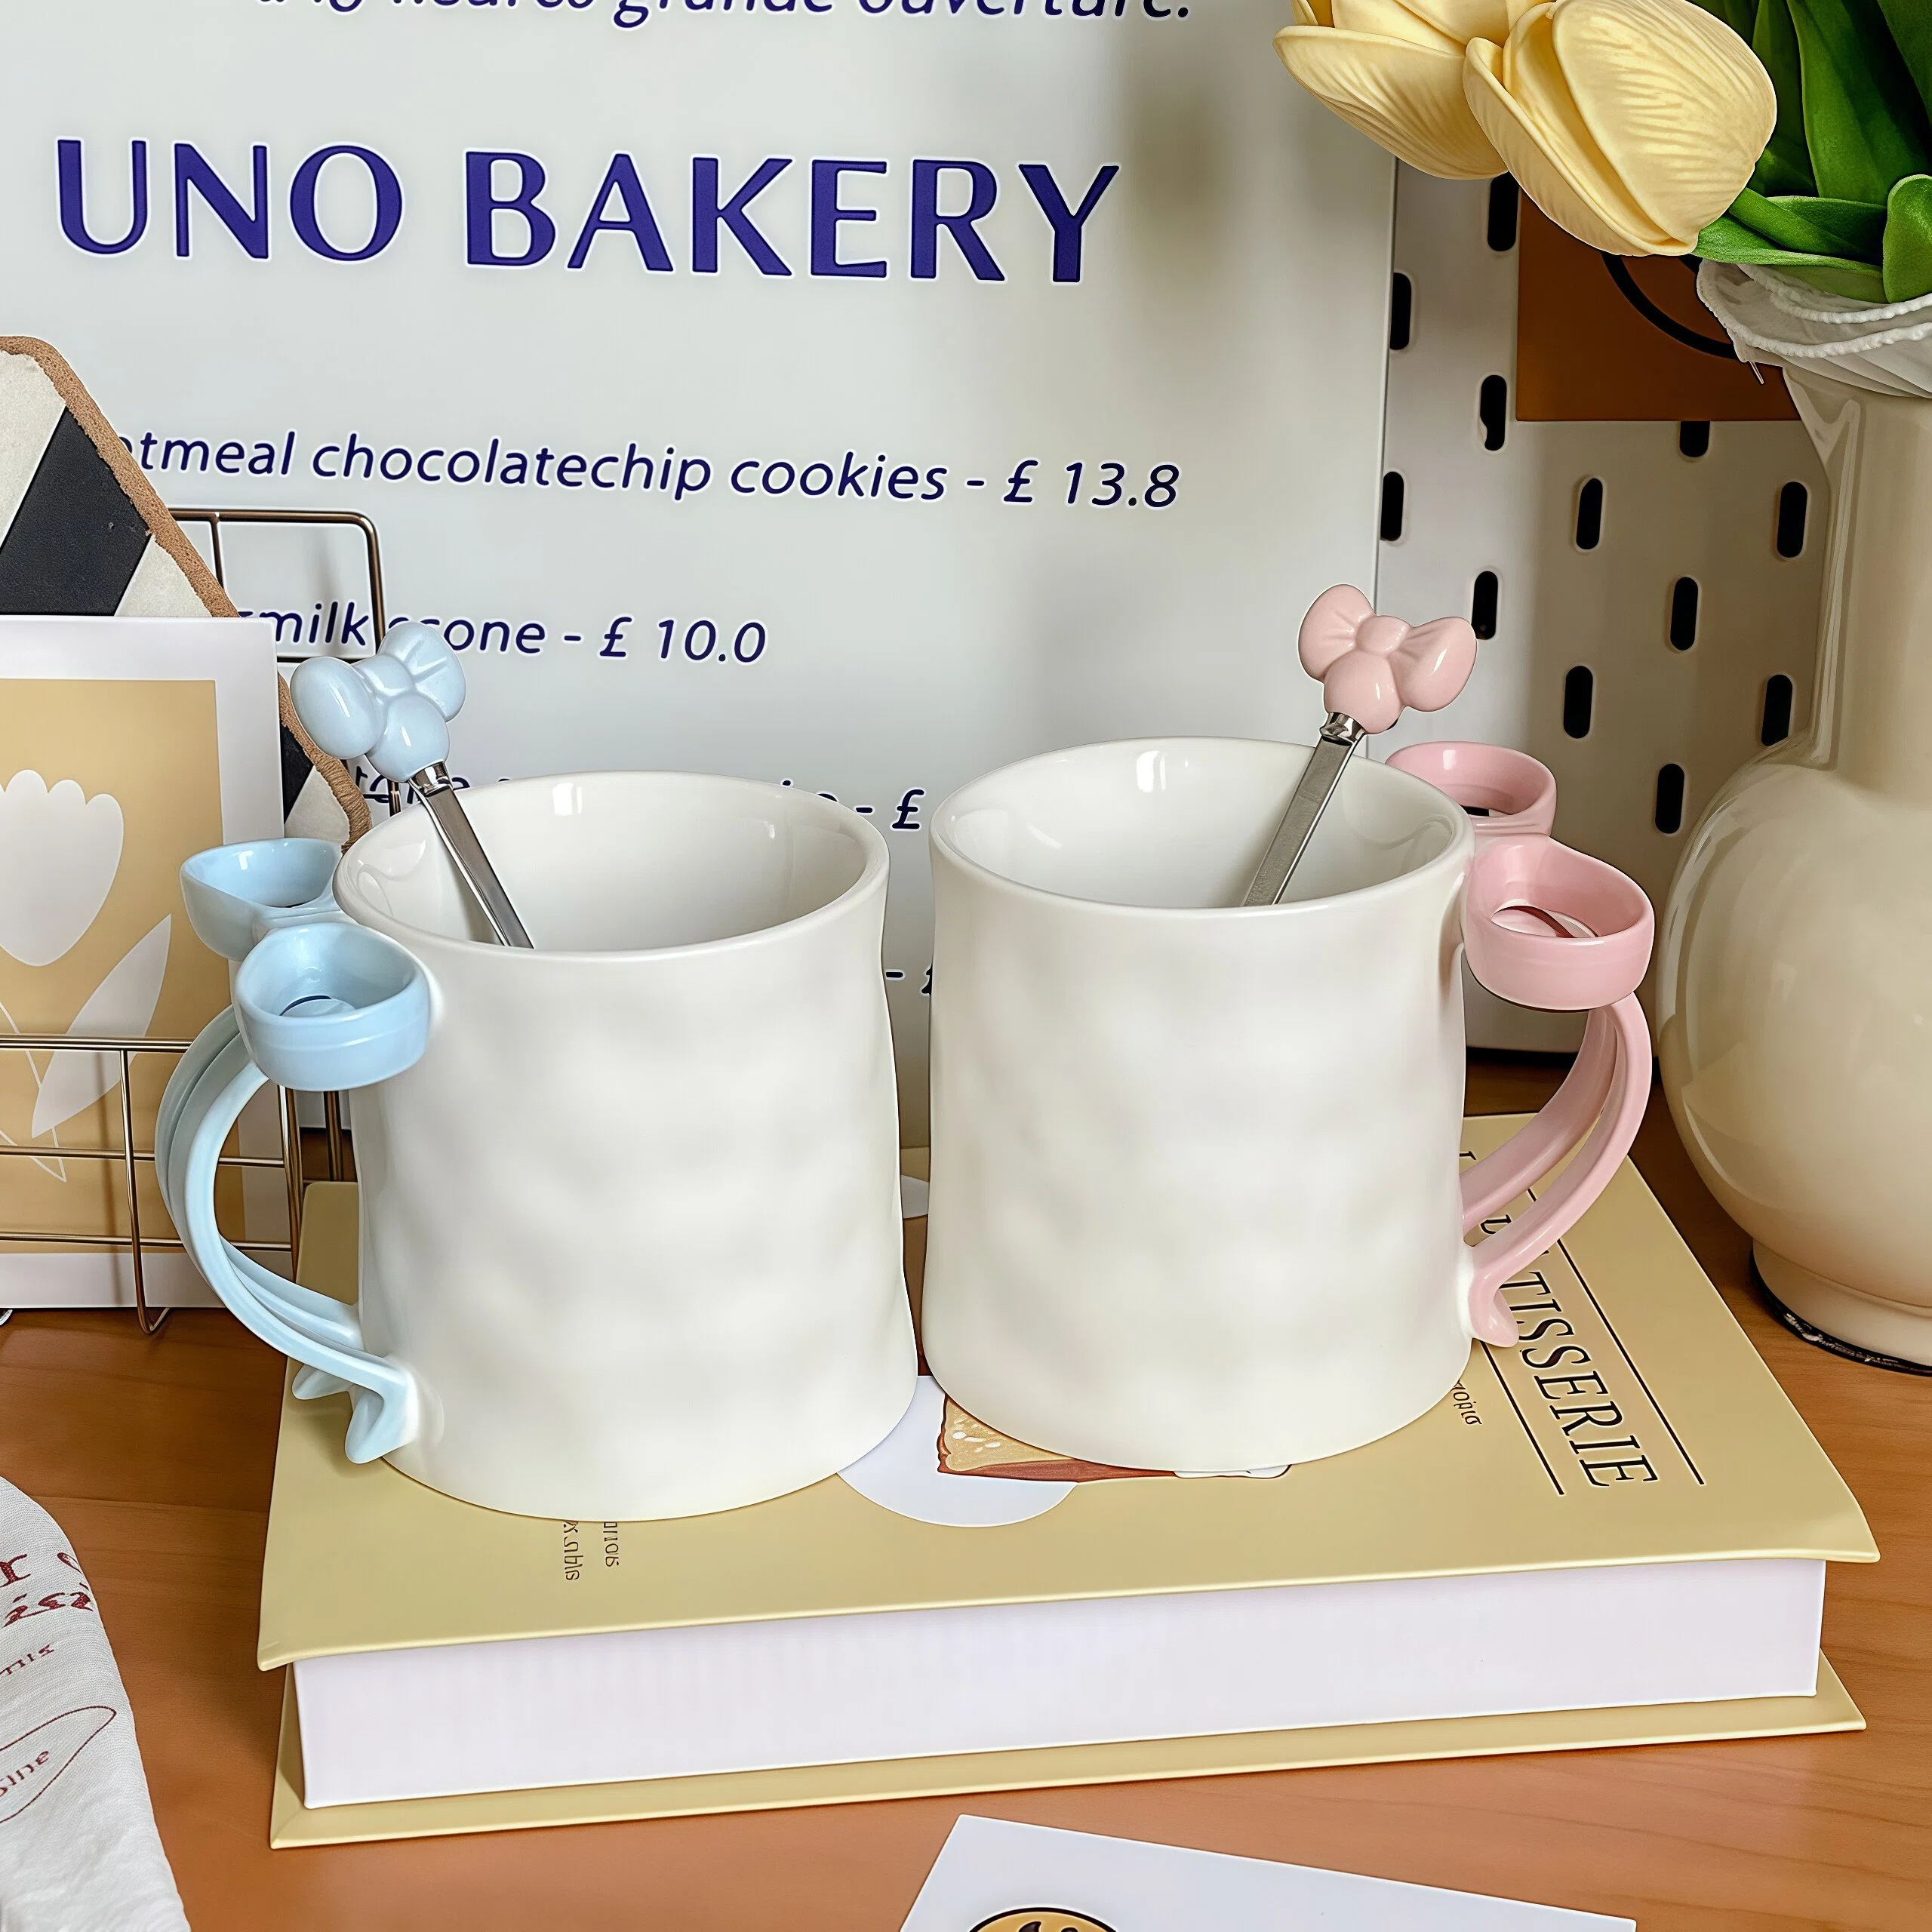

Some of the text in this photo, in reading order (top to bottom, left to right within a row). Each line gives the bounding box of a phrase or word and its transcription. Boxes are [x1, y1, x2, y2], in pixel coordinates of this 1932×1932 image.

[57, 139, 1120, 283] UNO BAKERY
[118, 431, 295, 475] tmeal
[312, 433, 712, 501] chocolatechip
[731, 451, 948, 500] cookies
[1003, 460, 1038, 503] £
[1066, 462, 1180, 508] 13.8
[238, 601, 369, 646] milk
[388, 617, 546, 654] one
[599, 617, 632, 657] £
[658, 620, 766, 663] 10.0
[1480, 1214, 1659, 1487] TISSERIE
